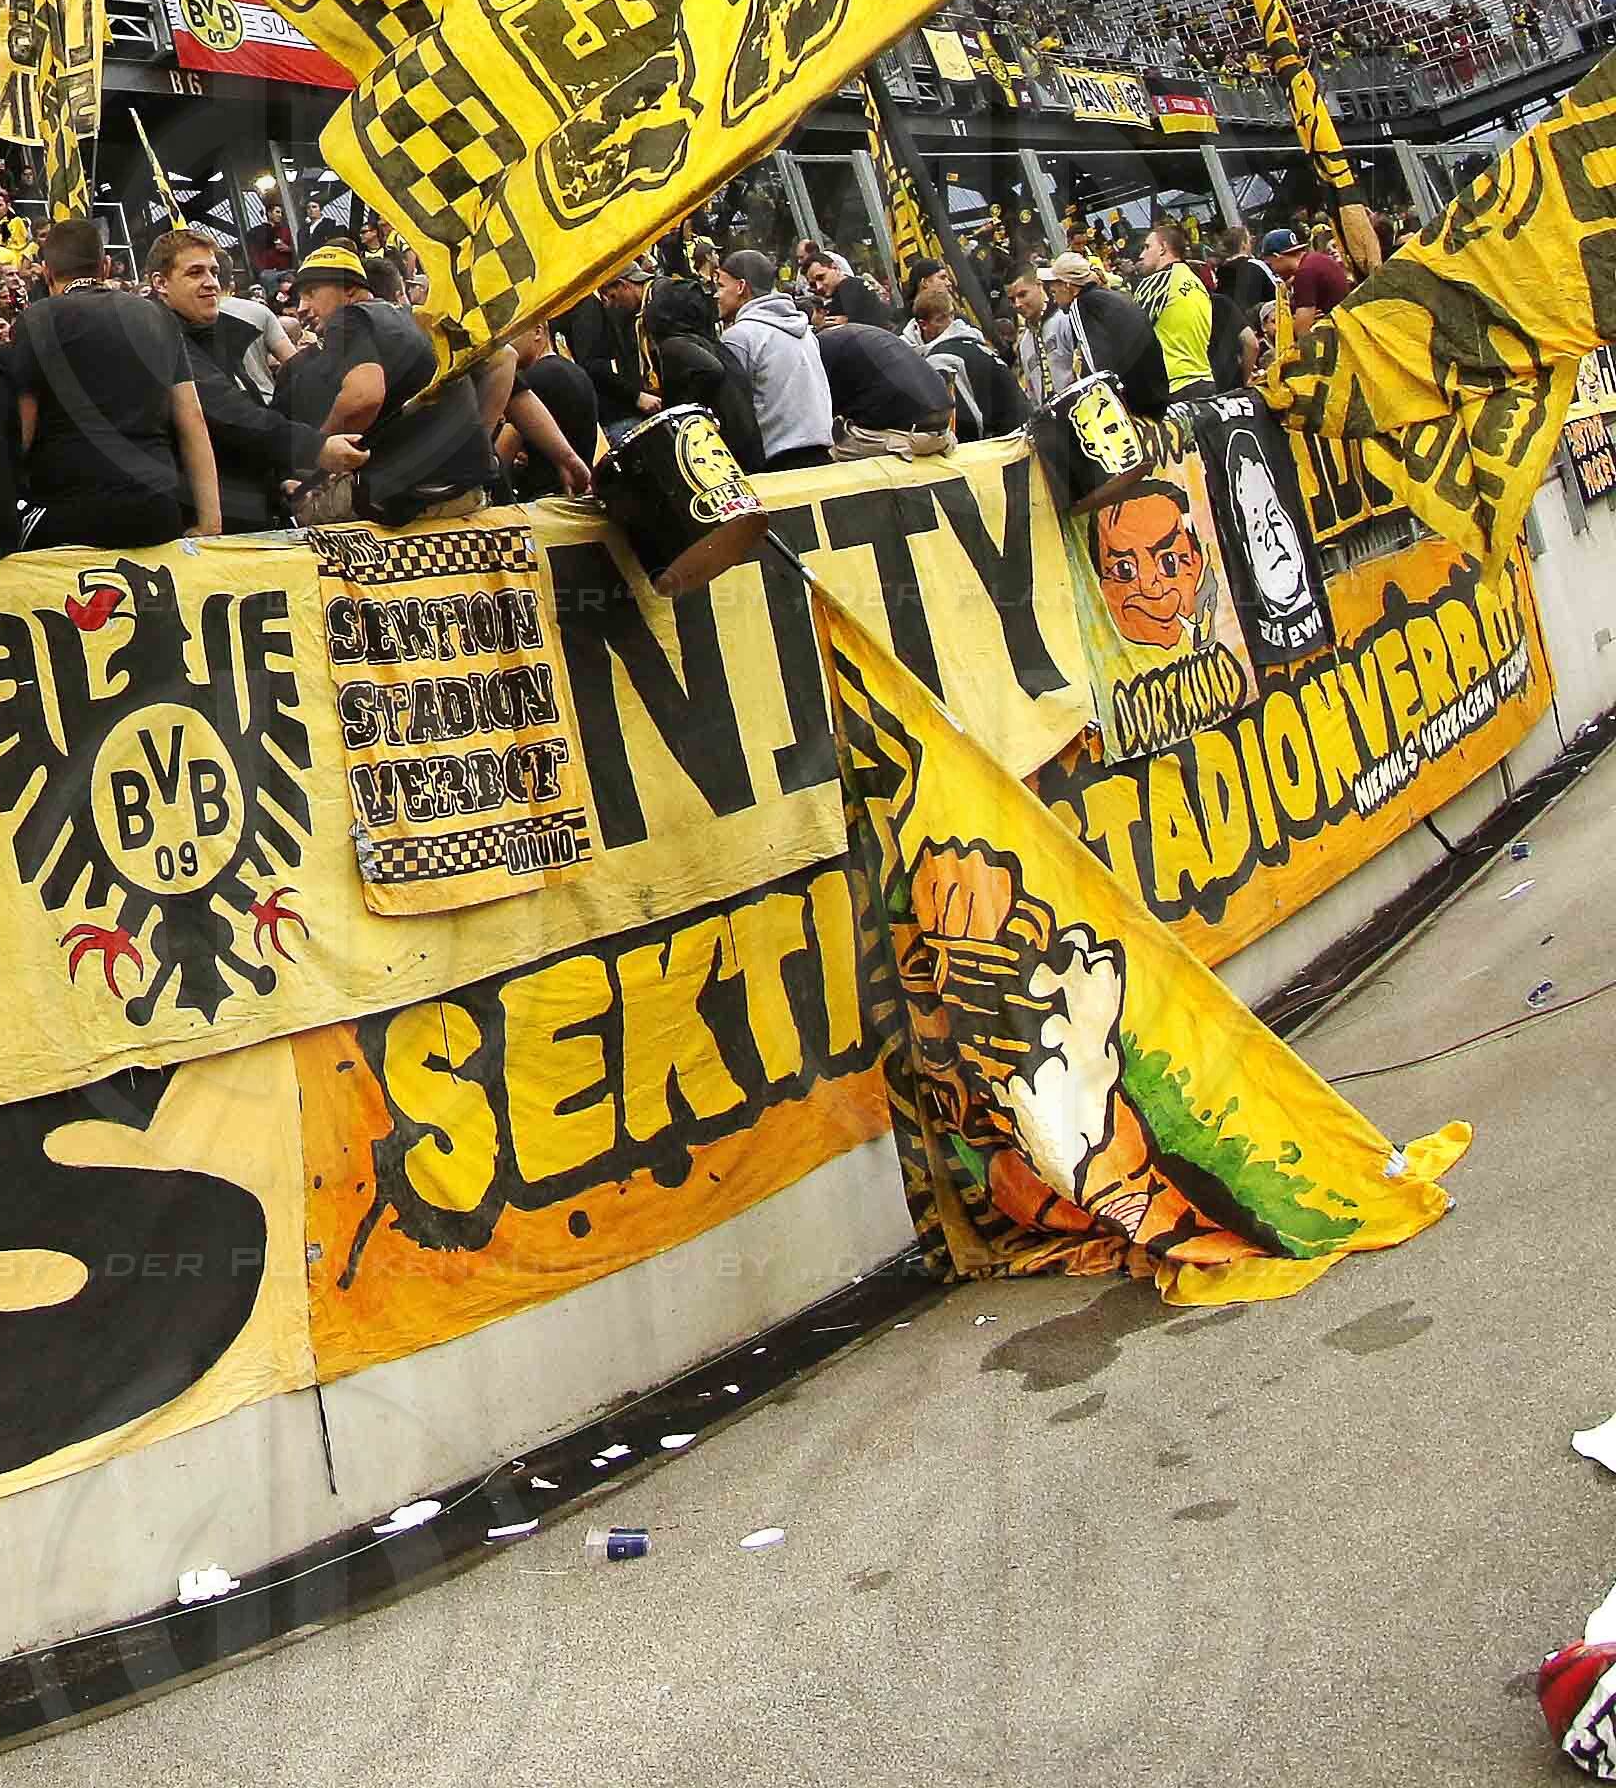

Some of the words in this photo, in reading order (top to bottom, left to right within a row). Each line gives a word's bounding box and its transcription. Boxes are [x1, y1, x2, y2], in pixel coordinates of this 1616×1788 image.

[325, 588, 546, 667] SEKTION
[334, 663, 564, 751] STADION
[1353, 740, 1419, 814] NIEMALS
[1419, 680, 1496, 757] VERZAGEN
[109, 723, 232, 853] BVB
[351, 738, 568, 827] VERBOT
[152, 842, 200, 884] 09
